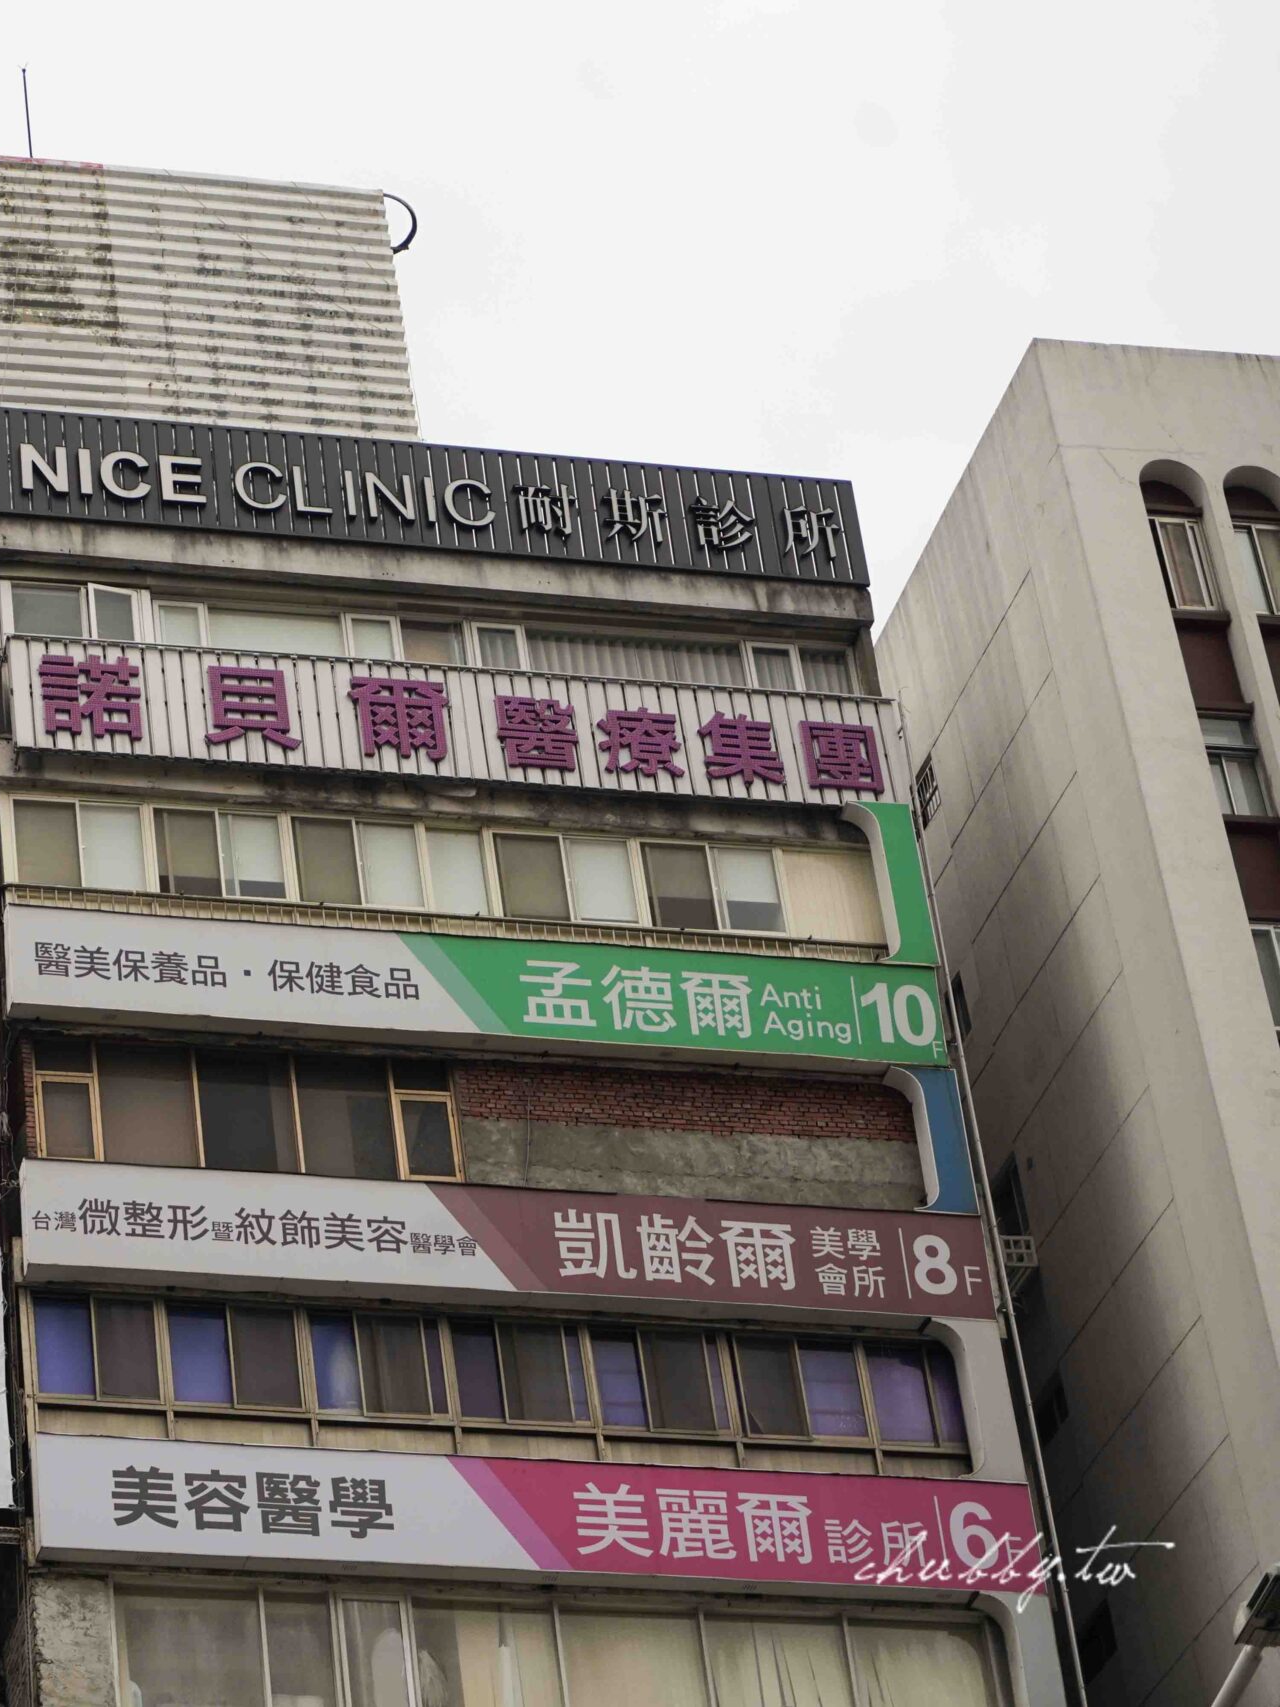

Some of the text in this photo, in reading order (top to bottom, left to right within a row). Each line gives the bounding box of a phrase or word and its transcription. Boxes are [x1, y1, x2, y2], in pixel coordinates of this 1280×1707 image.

[19, 442, 841, 561] NICE CLINIC 耐斯診所
[38, 653, 886, 794] 諾貝爾醫療集團
[519, 959, 753, 1039] 孟德爾
[760, 983, 822, 1010] Anti
[763, 1012, 852, 1045] Aging
[553, 1208, 797, 1292] 凱齡爾
[810, 1226, 881, 1260] 美學
[815, 1264, 885, 1299] 會所
[112, 1466, 395, 1541] 美容醫學
[575, 1483, 814, 1566] 美麗爾
[824, 1518, 928, 1568] 診所
